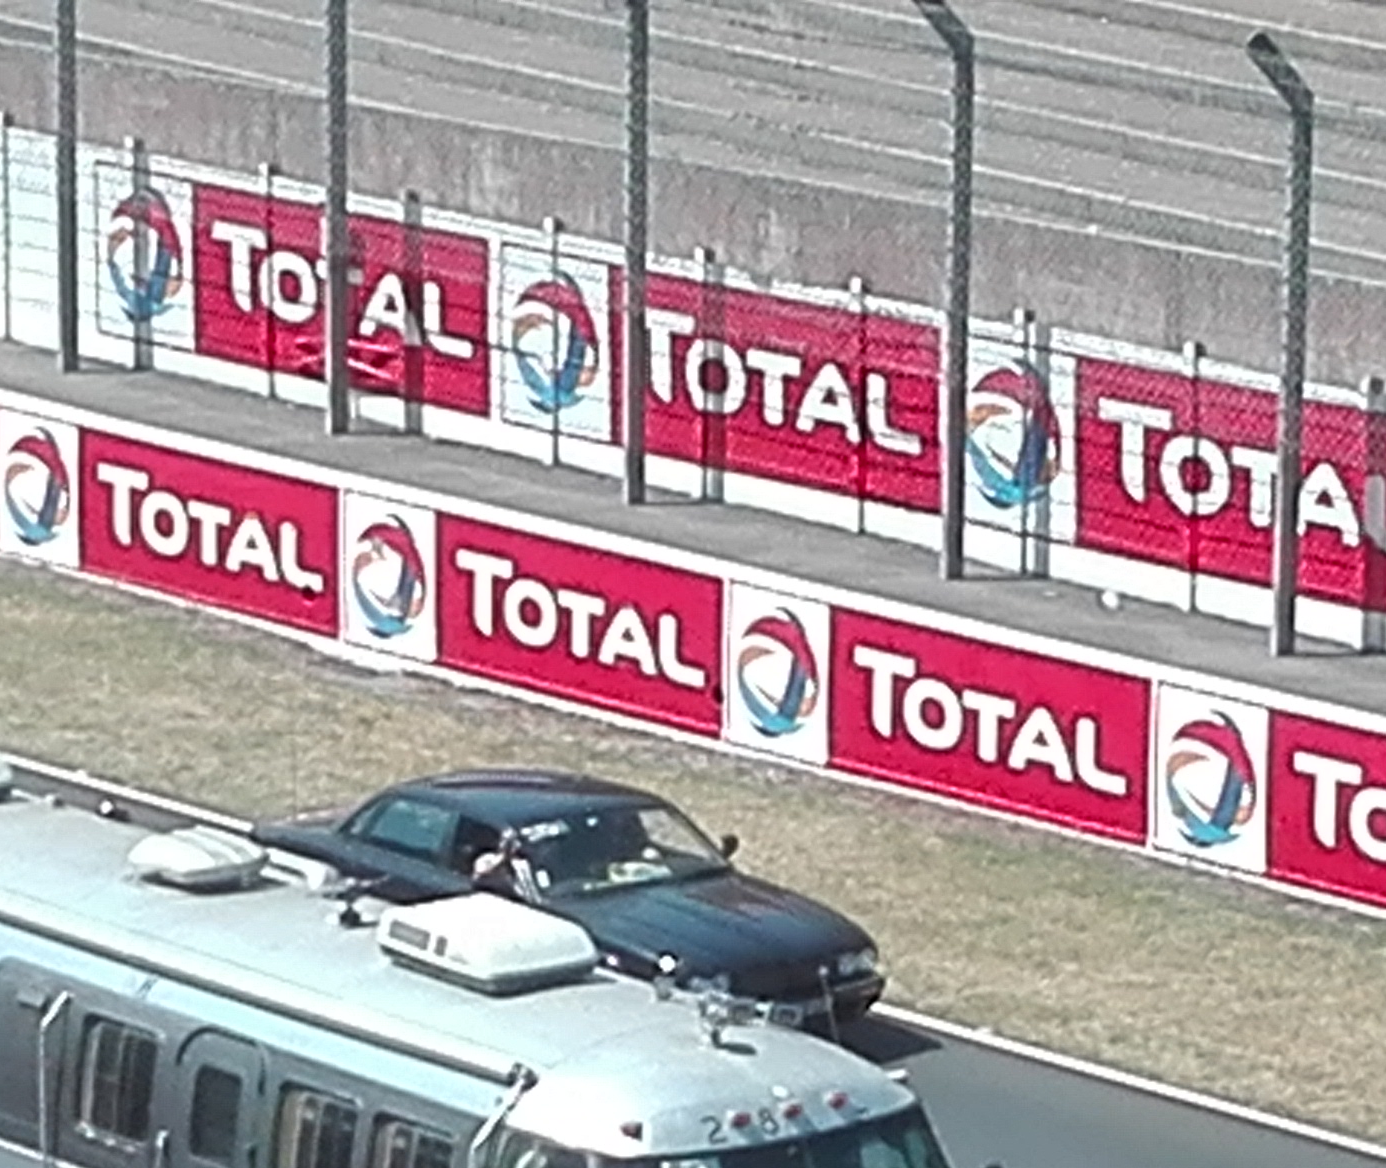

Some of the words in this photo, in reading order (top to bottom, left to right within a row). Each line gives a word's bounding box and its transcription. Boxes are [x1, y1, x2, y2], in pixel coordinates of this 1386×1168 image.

[643, 304, 923, 456] TOTAL
[96, 461, 325, 594] TOTAL
[454, 547, 706, 689] TOTAL
[852, 644, 1128, 797] TOTAL
